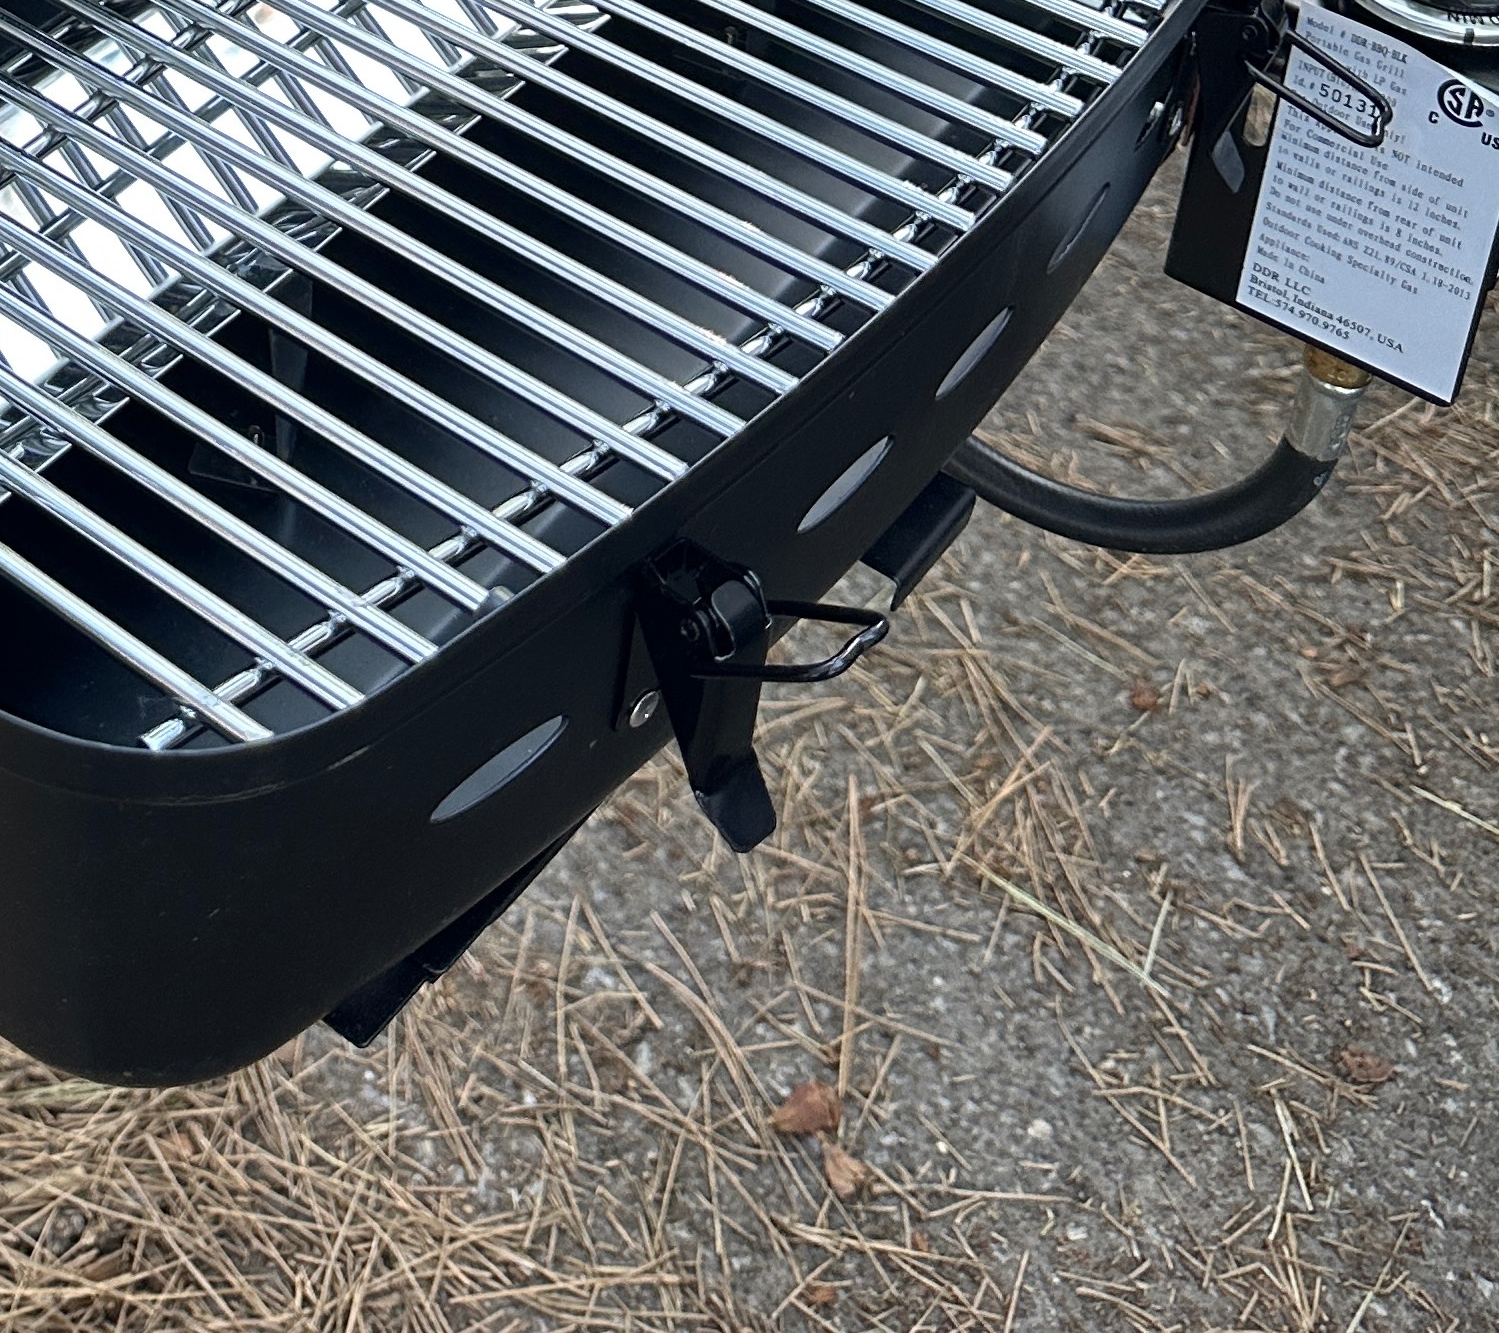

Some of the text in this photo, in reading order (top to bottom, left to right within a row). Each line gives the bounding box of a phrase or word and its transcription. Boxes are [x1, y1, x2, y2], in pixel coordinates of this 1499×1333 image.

[1306, 16, 1334, 34] Model
[1304, 29, 1404, 79] Portable Gas Grill
[1318, 82, 1378, 119] 50131
[1372, 73, 1386, 86] LP
[1427, 110, 1439, 124] C
[1306, 128, 1364, 160] Commercial
[1369, 154, 1389, 171] Use
[1391, 149, 1410, 164] NOT
[1416, 159, 1464, 187] intended
[1280, 130, 1468, 219] Minimum distance from side of unit
[1292, 152, 1320, 169] walls
[1324, 166, 1336, 176] or
[1341, 173, 1385, 197] railings
[1391, 192, 1402, 205] is
[1407, 199, 1419, 212] 12
[1265, 201, 1312, 229] Standards
[1268, 185, 1281, 198] Do
[1284, 194, 1300, 207] not
[1305, 204, 1322, 216] use
[1325, 213, 1353, 230] under
[1357, 227, 1401, 252] overhead
[1272, 174, 1284, 185] to
[1287, 181, 1309, 196] wall
[1313, 194, 1325, 203] or
[1330, 201, 1374, 225] railings
[1379, 220, 1390, 233] is
[1275, 160, 1462, 250] Minimum distance from rear of unit
[1256, 244, 1278, 262] Made
[1298, 264, 1325, 284] China
[1262, 216, 1418, 295] Outdoor Cooking Specialty Gas
[1252, 261, 1311, 296] DDR LLC
[1292, 293, 1333, 320] Indiana
[1377, 333, 1403, 353] USA
